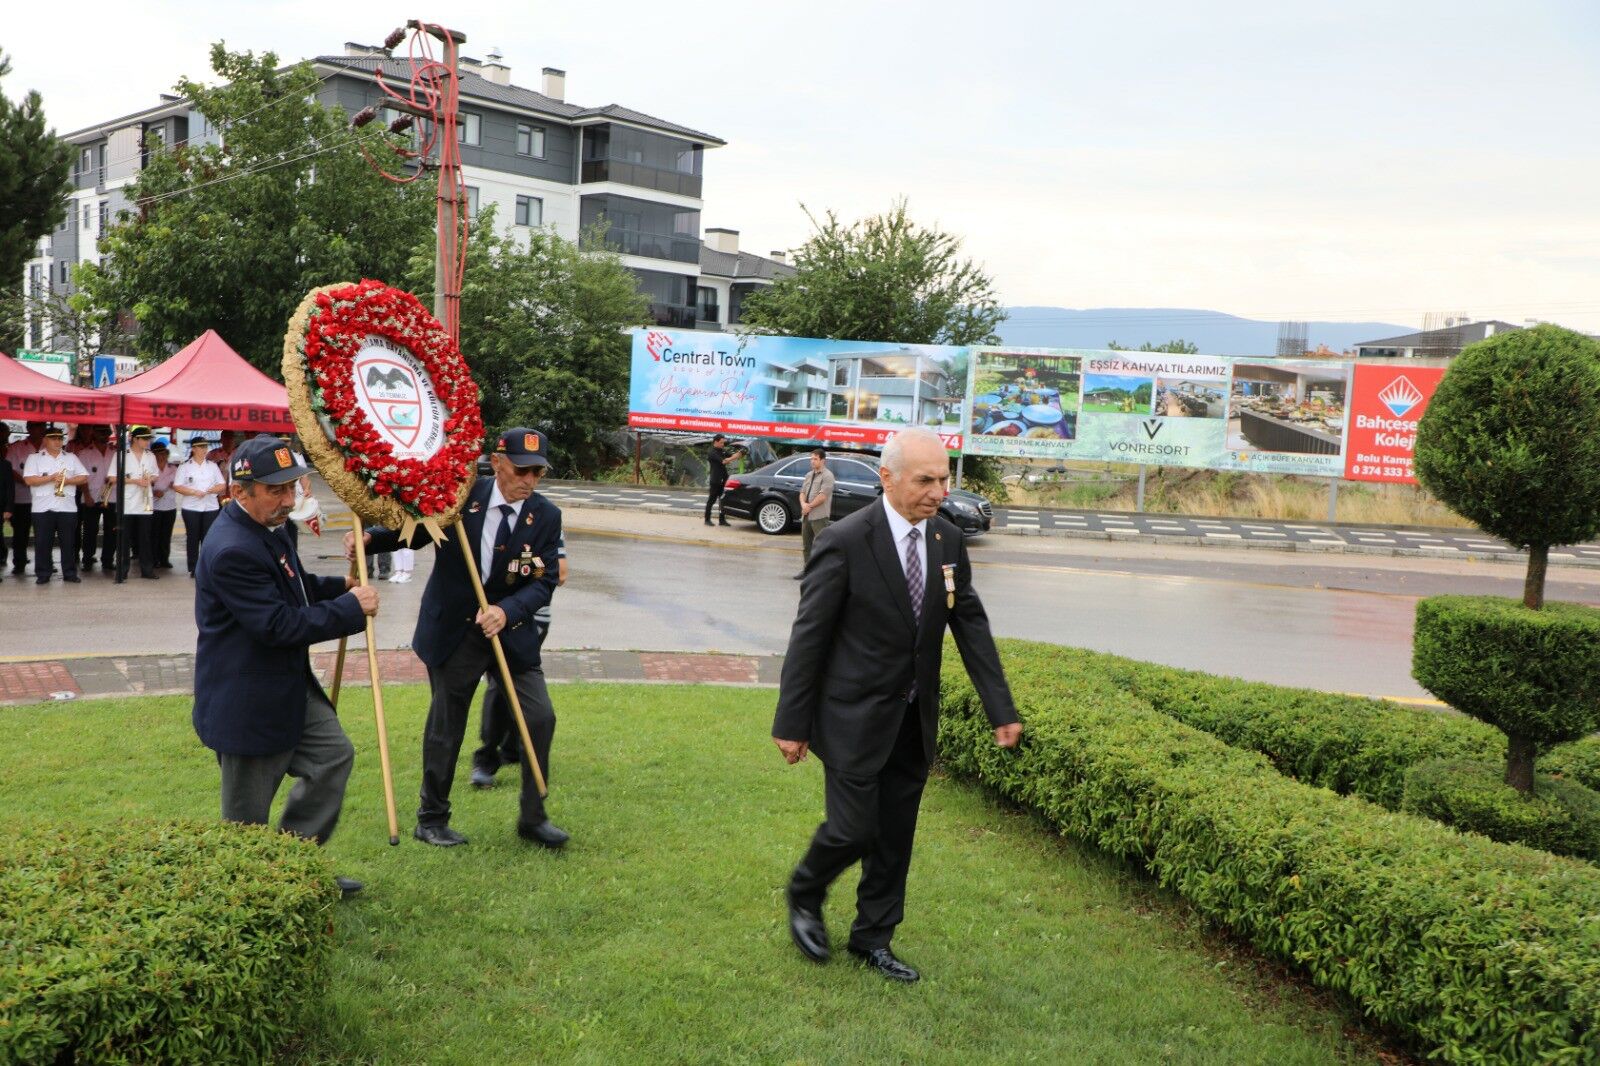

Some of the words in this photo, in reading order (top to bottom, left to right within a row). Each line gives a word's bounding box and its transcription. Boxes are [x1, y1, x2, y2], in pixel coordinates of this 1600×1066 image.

[663, 348, 715, 365] Central
[718, 351, 756, 368] Town
[1122, 361, 1226, 375] KAHVALTILARIMIZ
[149, 404, 184, 419] T.C.
[191, 406, 240, 421] BOLU
[248, 409, 291, 423] BELE
[727, 423, 770, 433] DANIŞMANLIK
[774, 425, 809, 435] DEĞERLEME
[1356, 414, 1421, 432] Bahçeşe
[1035, 440, 1072, 448] KAHVALTI
[1109, 441, 1191, 455] VONRESORT
[1292, 456, 1331, 465] KAHVALTI
[1357, 453, 1380, 463] Bolu
[1383, 455, 1413, 467] Kamp
[1352, 465, 1360, 474] 0
[1362, 465, 1381, 476] 374
[1383, 466, 1403, 477] 333
